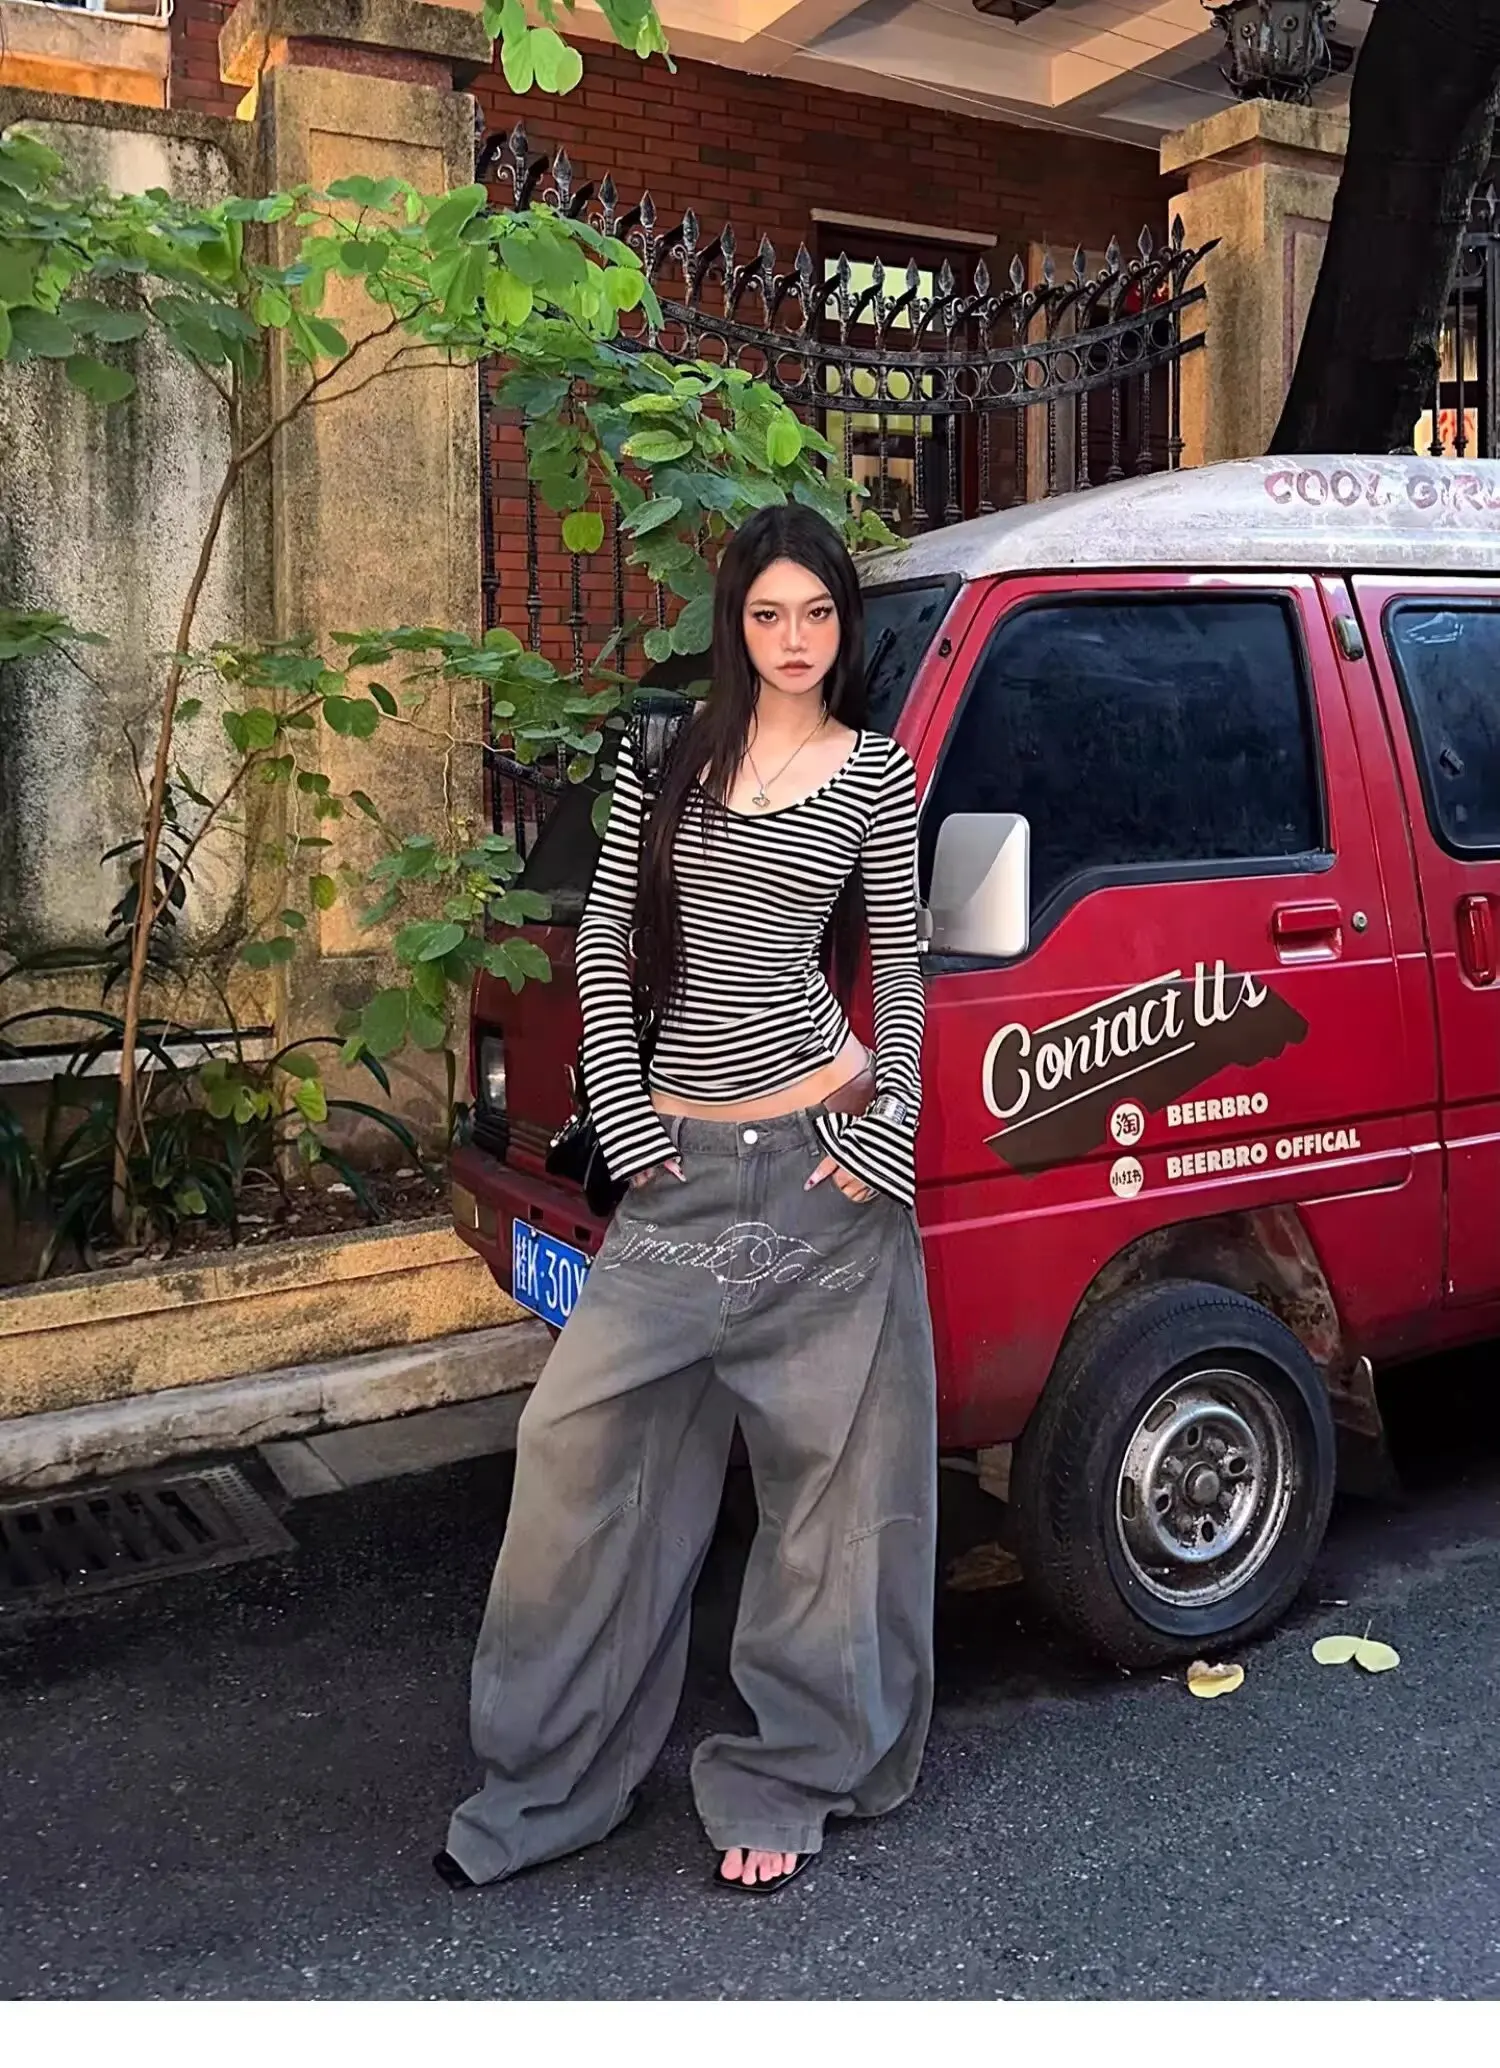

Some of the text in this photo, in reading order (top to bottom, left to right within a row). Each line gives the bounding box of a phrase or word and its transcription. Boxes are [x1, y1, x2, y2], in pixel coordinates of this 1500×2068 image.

[1264, 469, 1391, 507] COOL
[982, 960, 1268, 1119] Contact Us
[1115, 1112, 1141, 1138] 淘
[1167, 1092, 1269, 1127] BEERBRO
[1167, 1128, 1361, 1179] BEERBRO OFFICAL
[1111, 1168, 1142, 1187] 小红书
